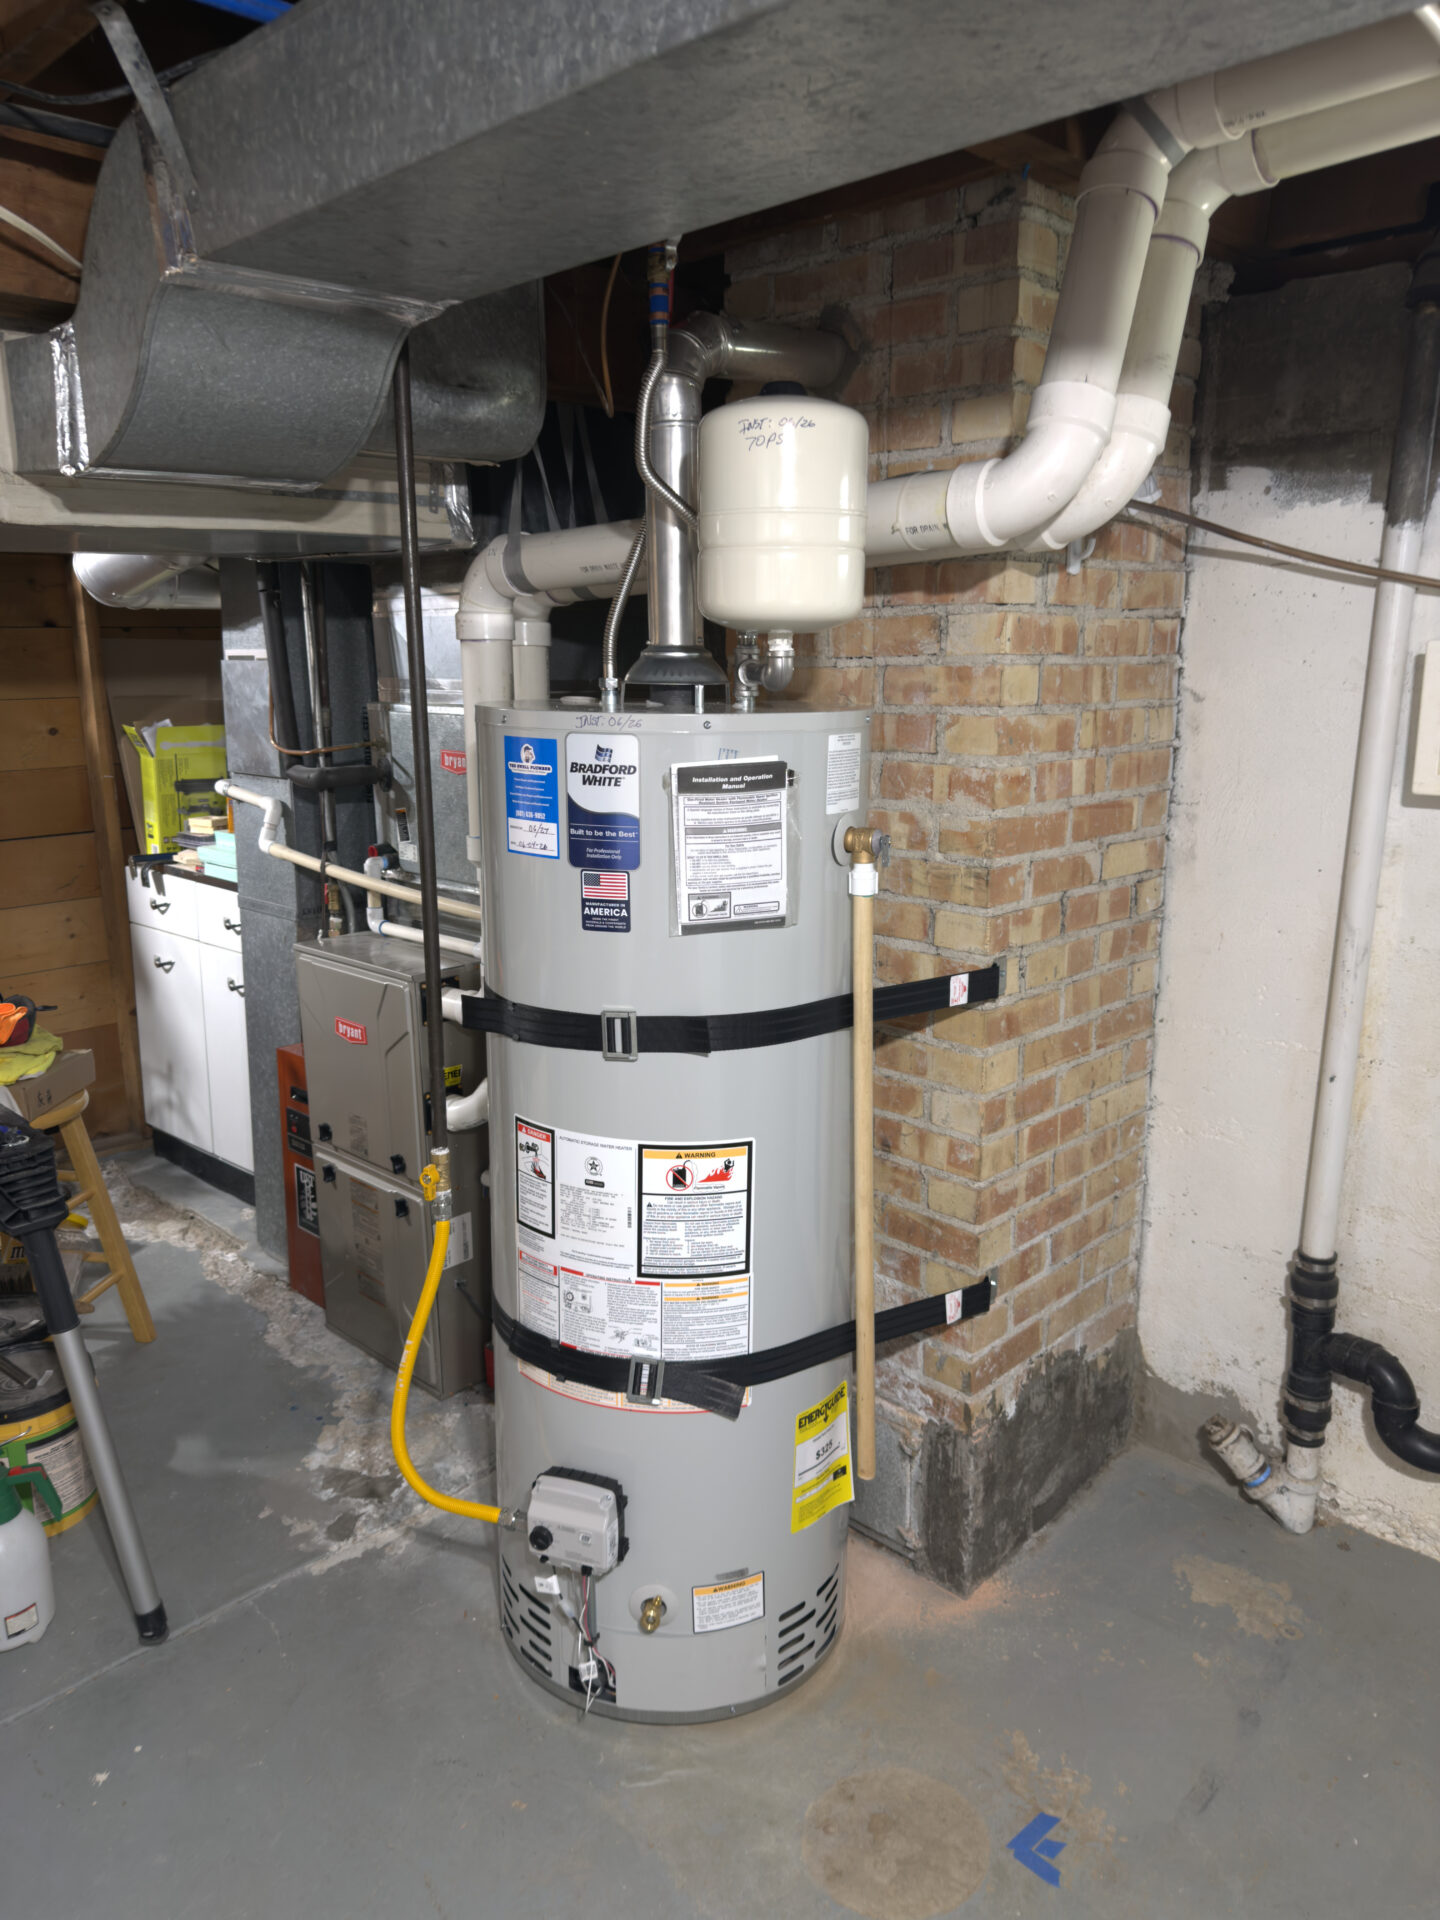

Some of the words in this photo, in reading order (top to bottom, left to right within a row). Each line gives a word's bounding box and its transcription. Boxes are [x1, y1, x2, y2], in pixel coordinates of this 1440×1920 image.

[608, 715, 643, 731] 06/26
[570, 762, 637, 775] BRADFORD
[582, 775, 622, 787] WHITE
[743, 773, 773, 782] Operation
[570, 828, 584, 836] Built
[594, 829, 603, 837] be
[618, 830, 636, 838] Best
[584, 907, 628, 917] AMERICA
[338, 1022, 362, 1040] bryant
[527, 1128, 547, 1140] DANGER
[815, 1439, 833, 1461] $325
[718, 1581, 746, 1592] WARNING
